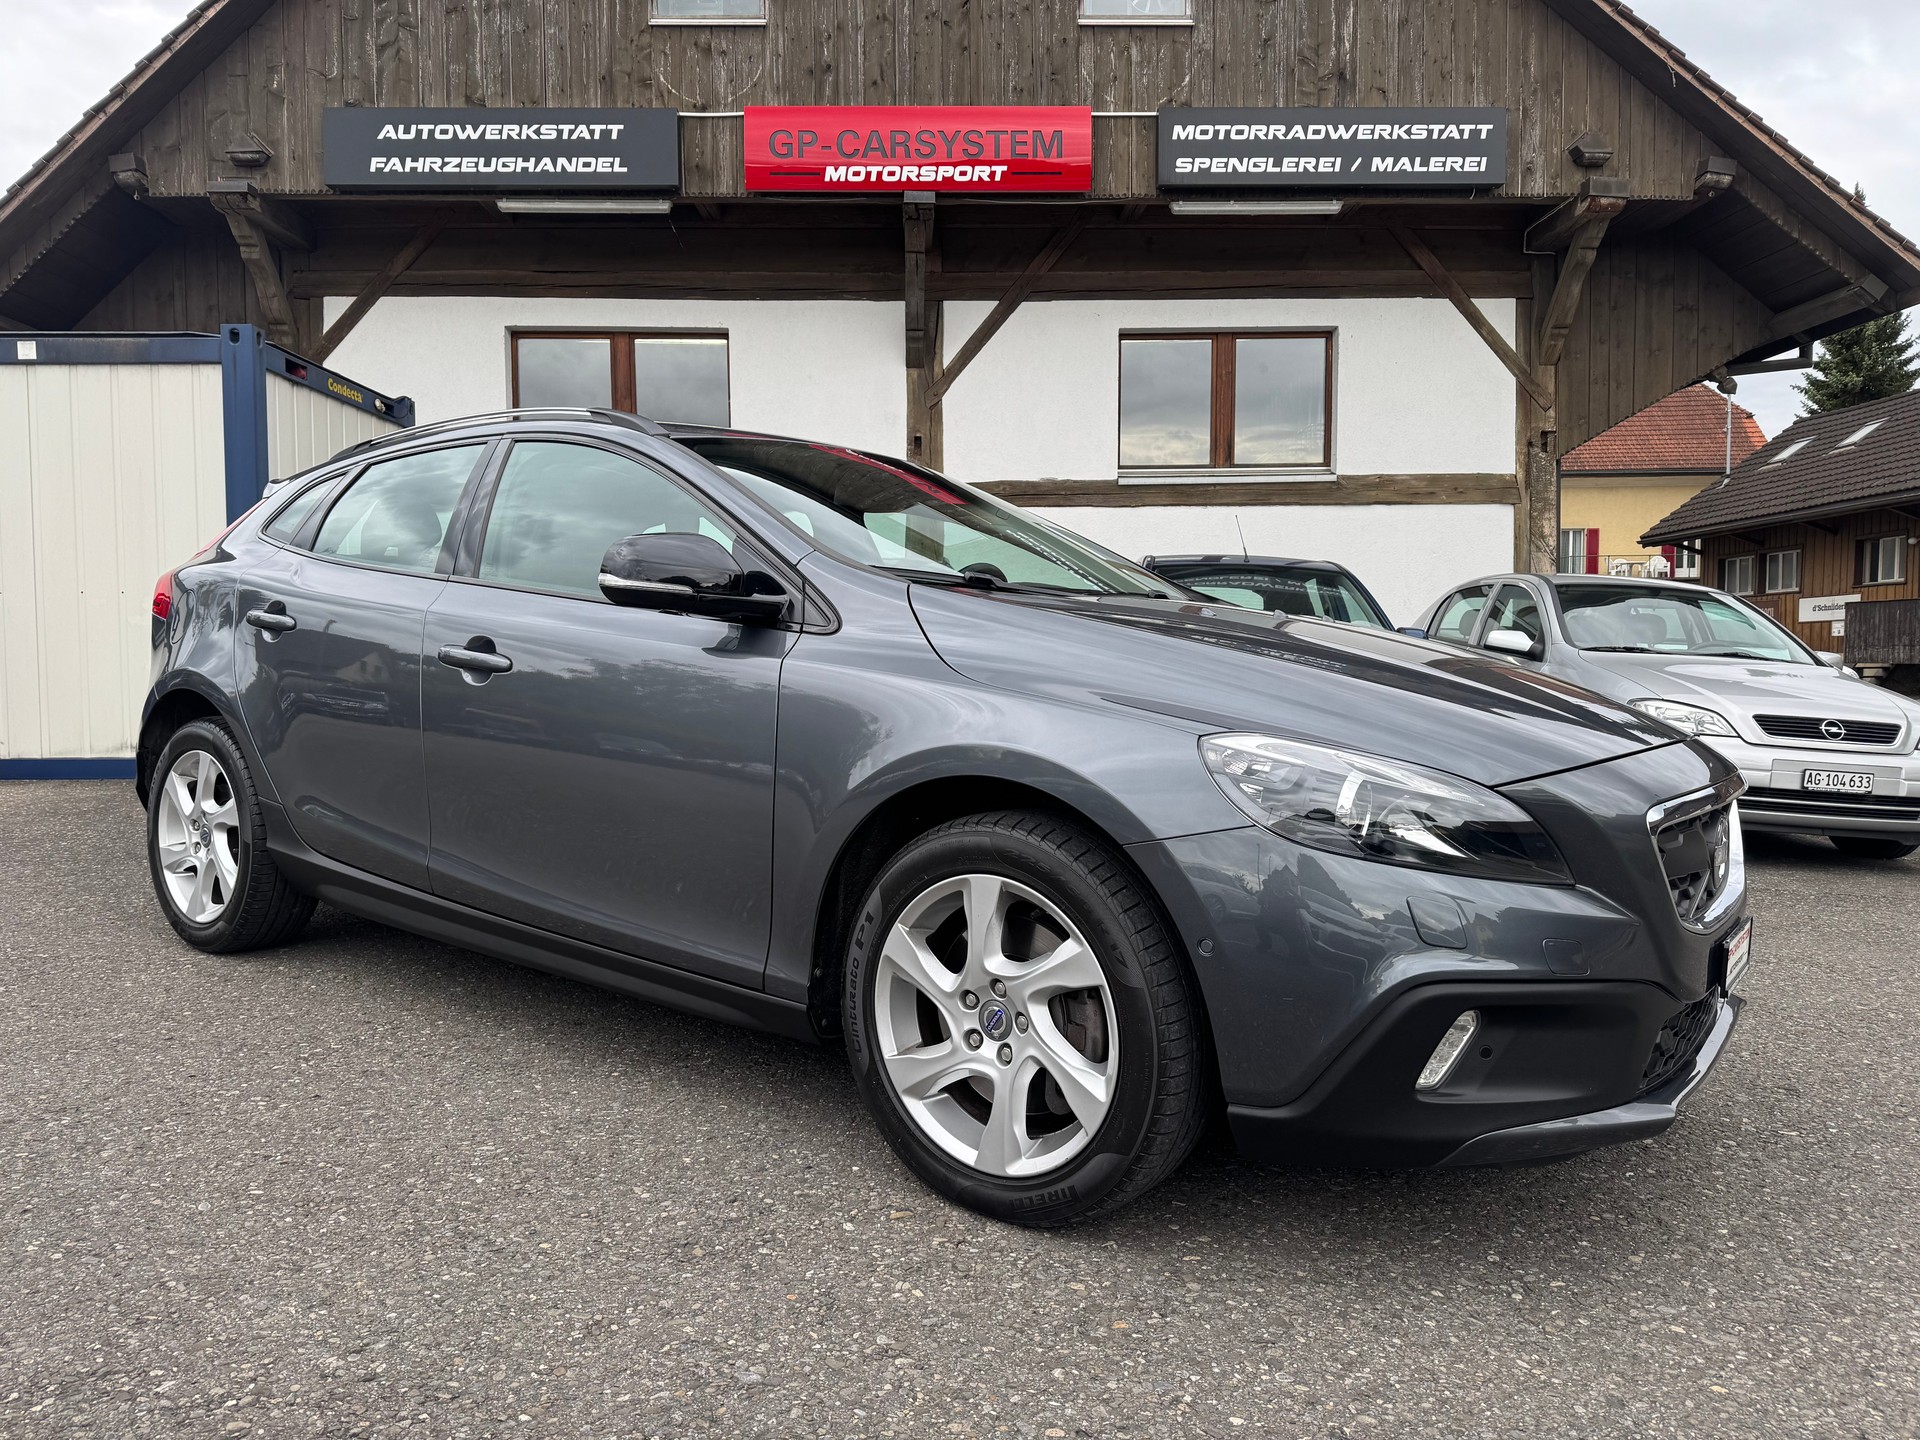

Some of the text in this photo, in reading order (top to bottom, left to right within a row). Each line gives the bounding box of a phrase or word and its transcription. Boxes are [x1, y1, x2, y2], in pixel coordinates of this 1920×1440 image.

[376, 124, 625, 140] AUTOWERKSTATT
[1171, 124, 1494, 140] MOTORRADWERKSTATT
[769, 129, 1063, 159] GP-CARSYSTEM
[369, 157, 628, 173] FAHRZEUGHANDEL
[1174, 156, 1342, 173] SPENGLEREI
[1370, 156, 1488, 172] MALEREI
[824, 165, 1008, 182] MOTORSPORT
[327, 377, 363, 403] Condecta
